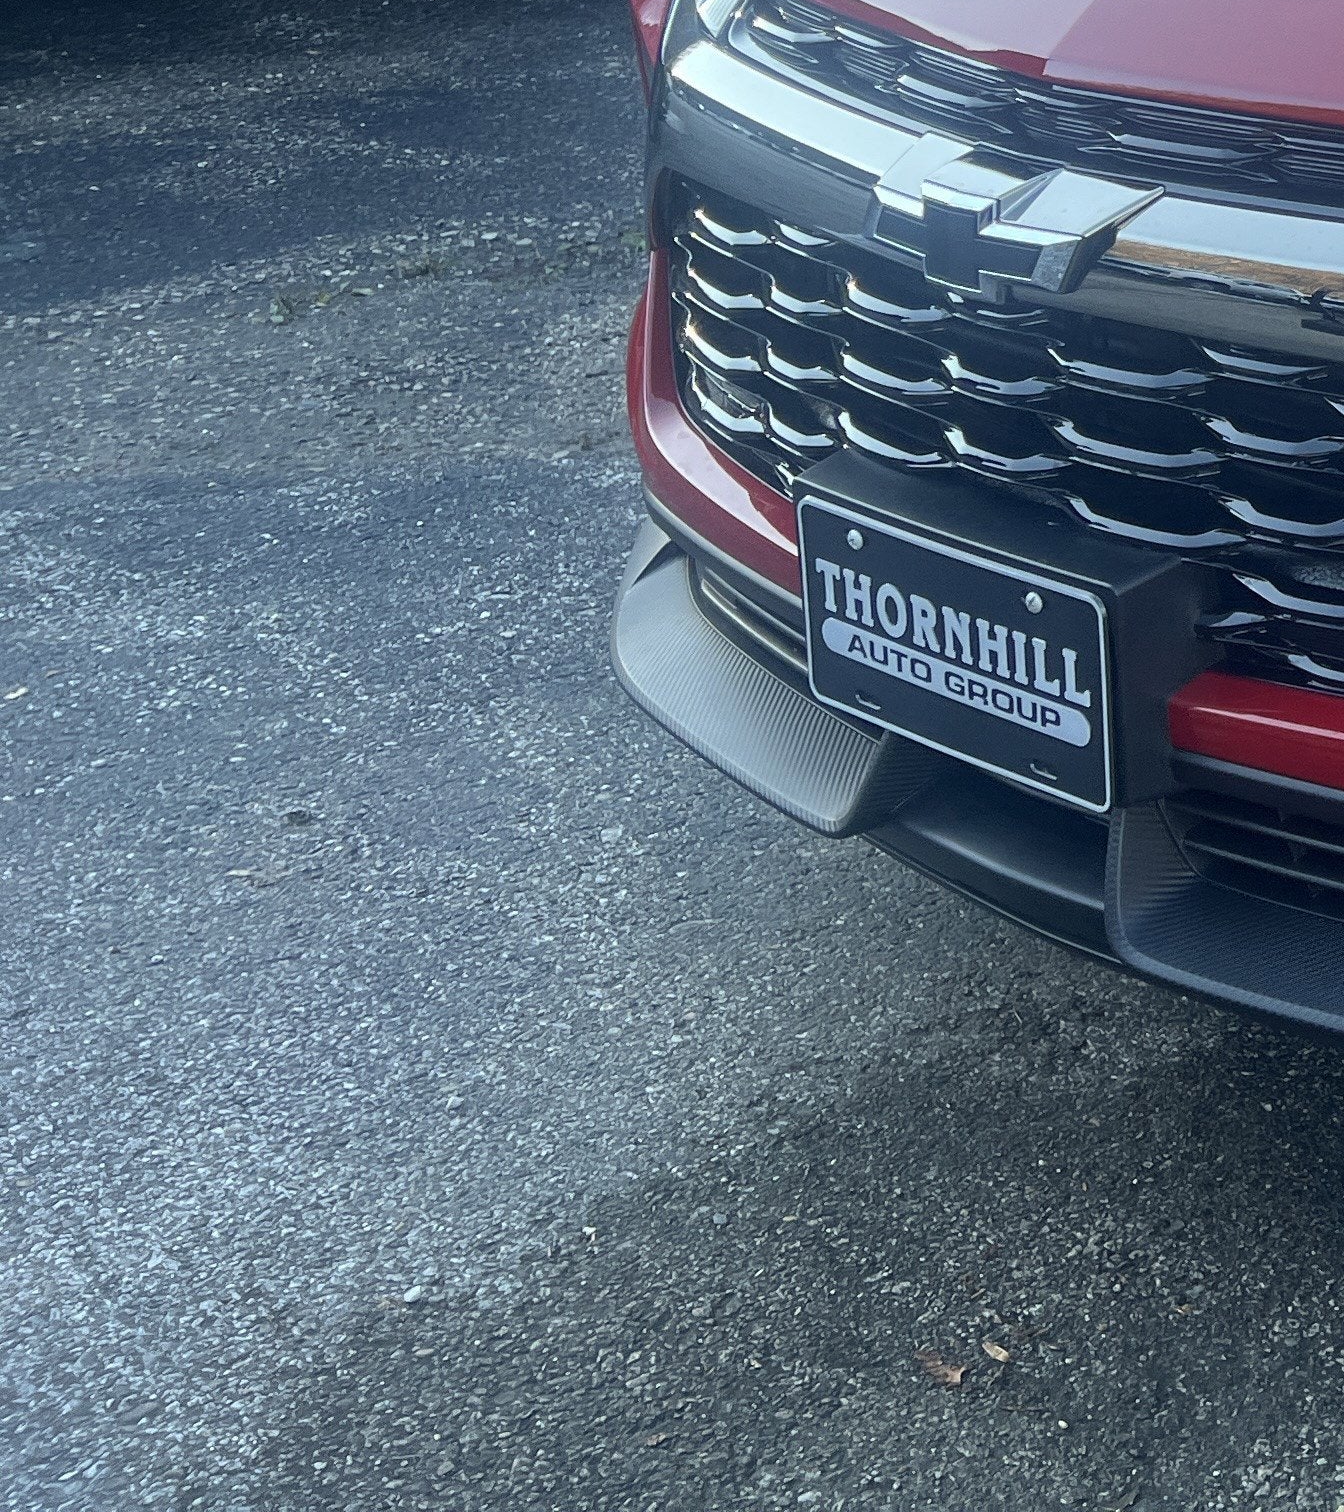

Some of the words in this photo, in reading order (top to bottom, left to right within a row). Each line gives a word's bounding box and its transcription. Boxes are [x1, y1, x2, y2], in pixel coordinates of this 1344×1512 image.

[815, 557, 1091, 708] THORNHILL
[847, 634, 932, 683] AUTO
[944, 671, 1061, 728] GROUP
